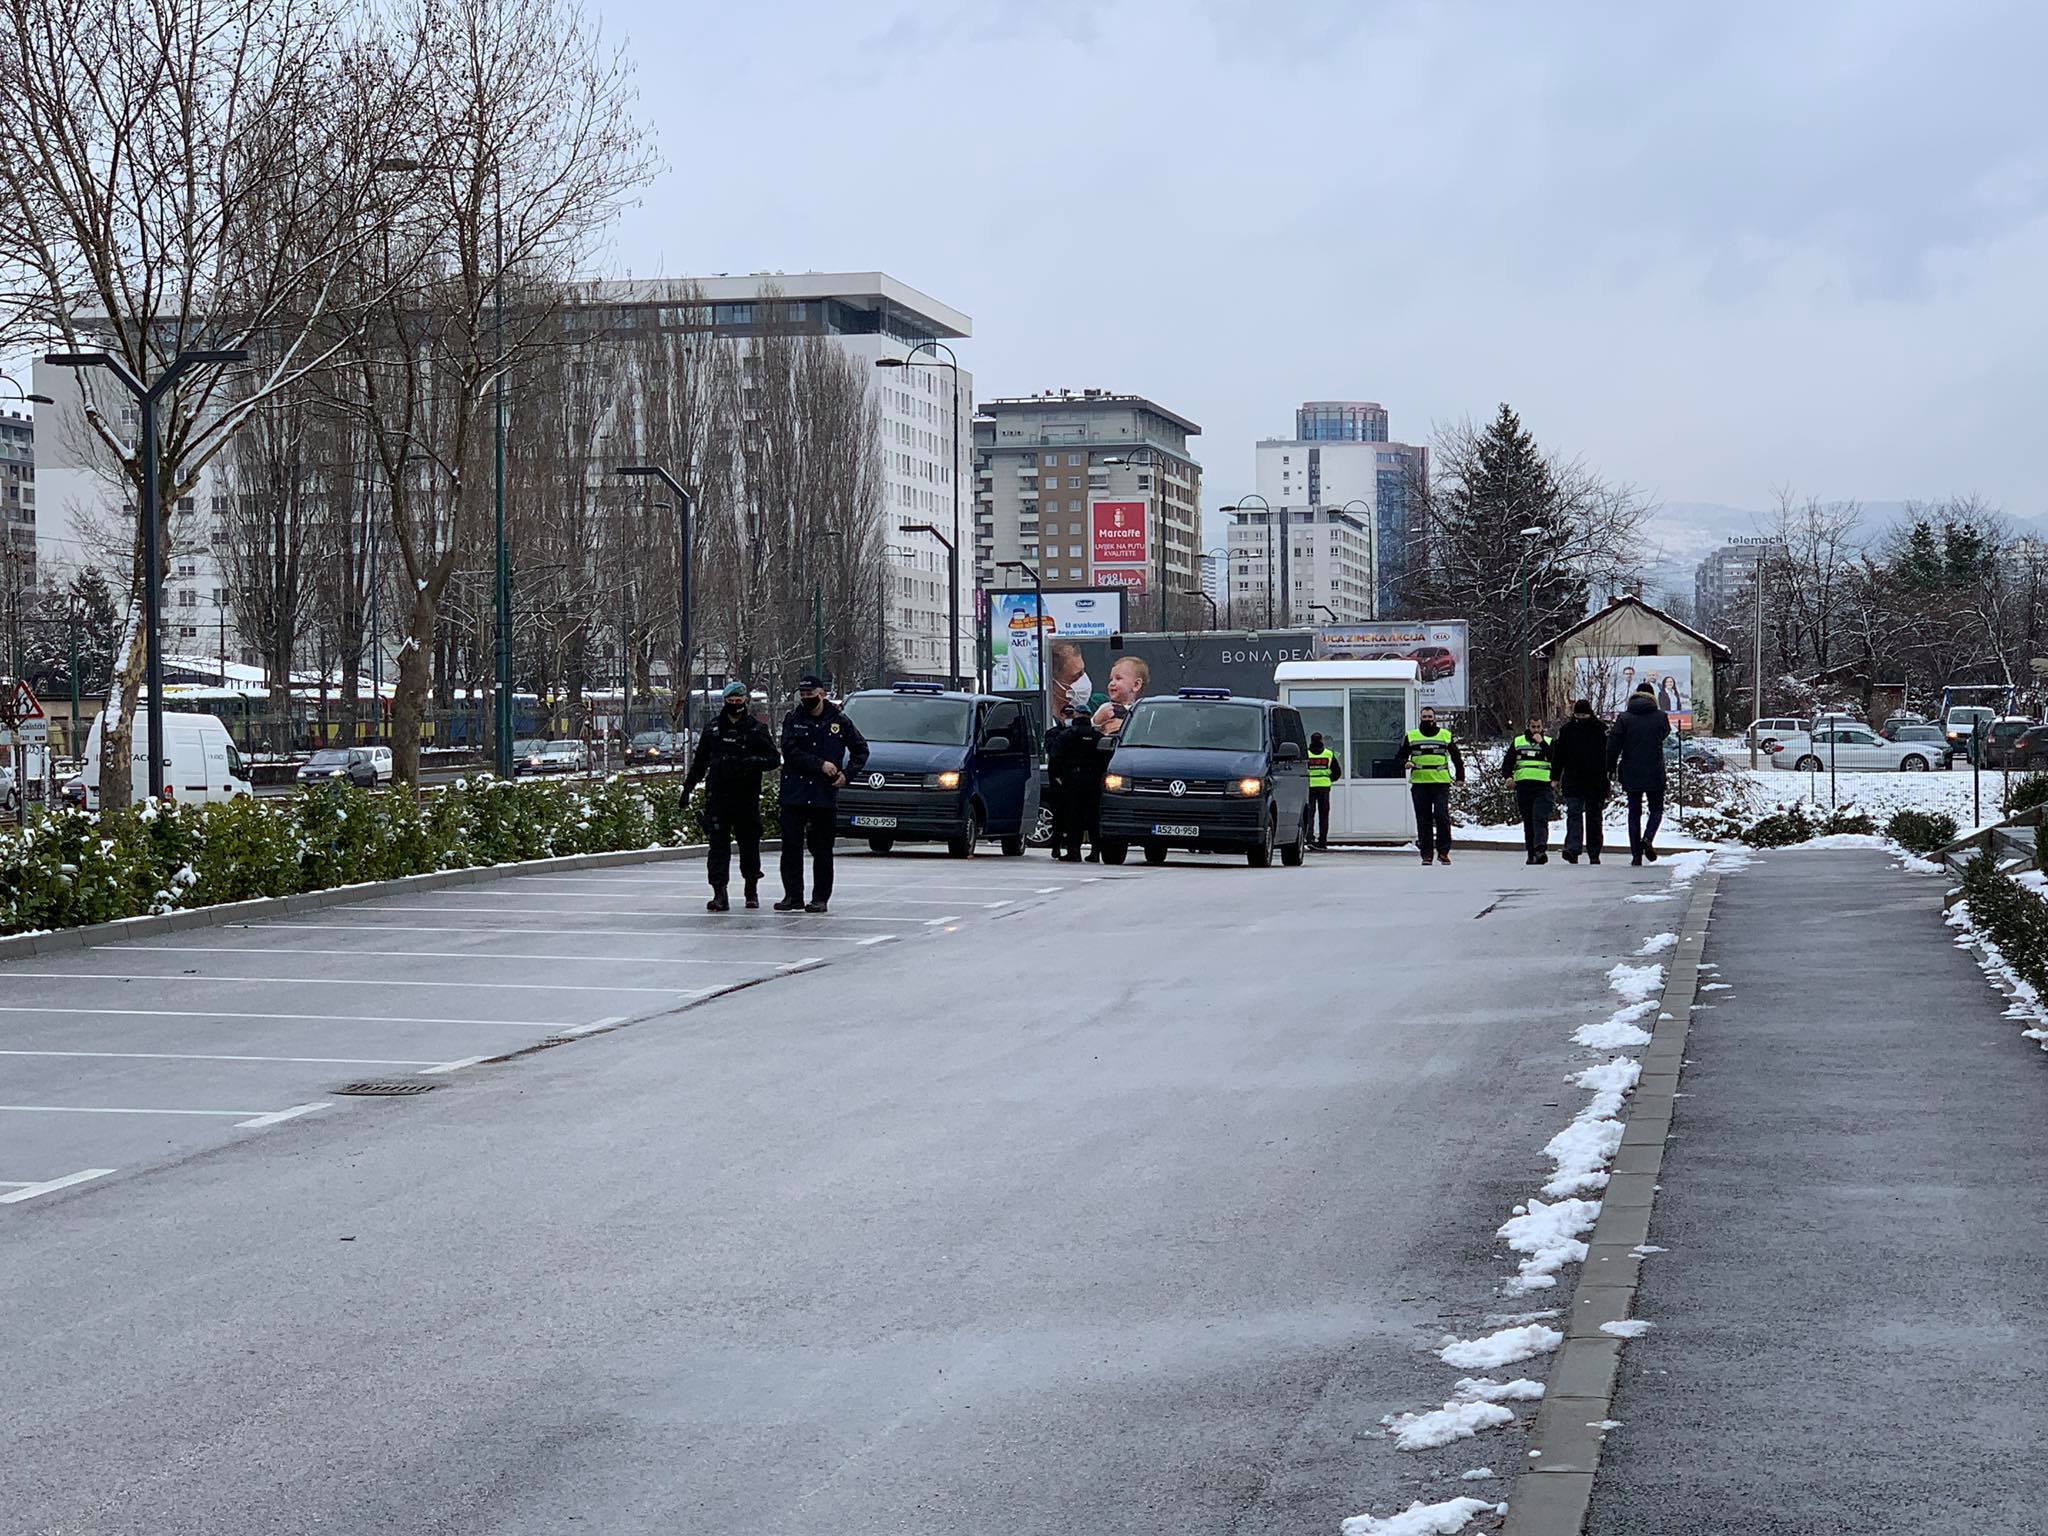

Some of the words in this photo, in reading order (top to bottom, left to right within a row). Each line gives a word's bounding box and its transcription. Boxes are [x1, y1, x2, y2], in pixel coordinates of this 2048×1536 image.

[1098, 529, 1141, 538] Marcaffe
[1727, 535, 1783, 545] telemach
[1388, 633, 1425, 642] AKCIJA
[1222, 650, 1272, 663] BONA
[1279, 649, 1314, 661] DEA
